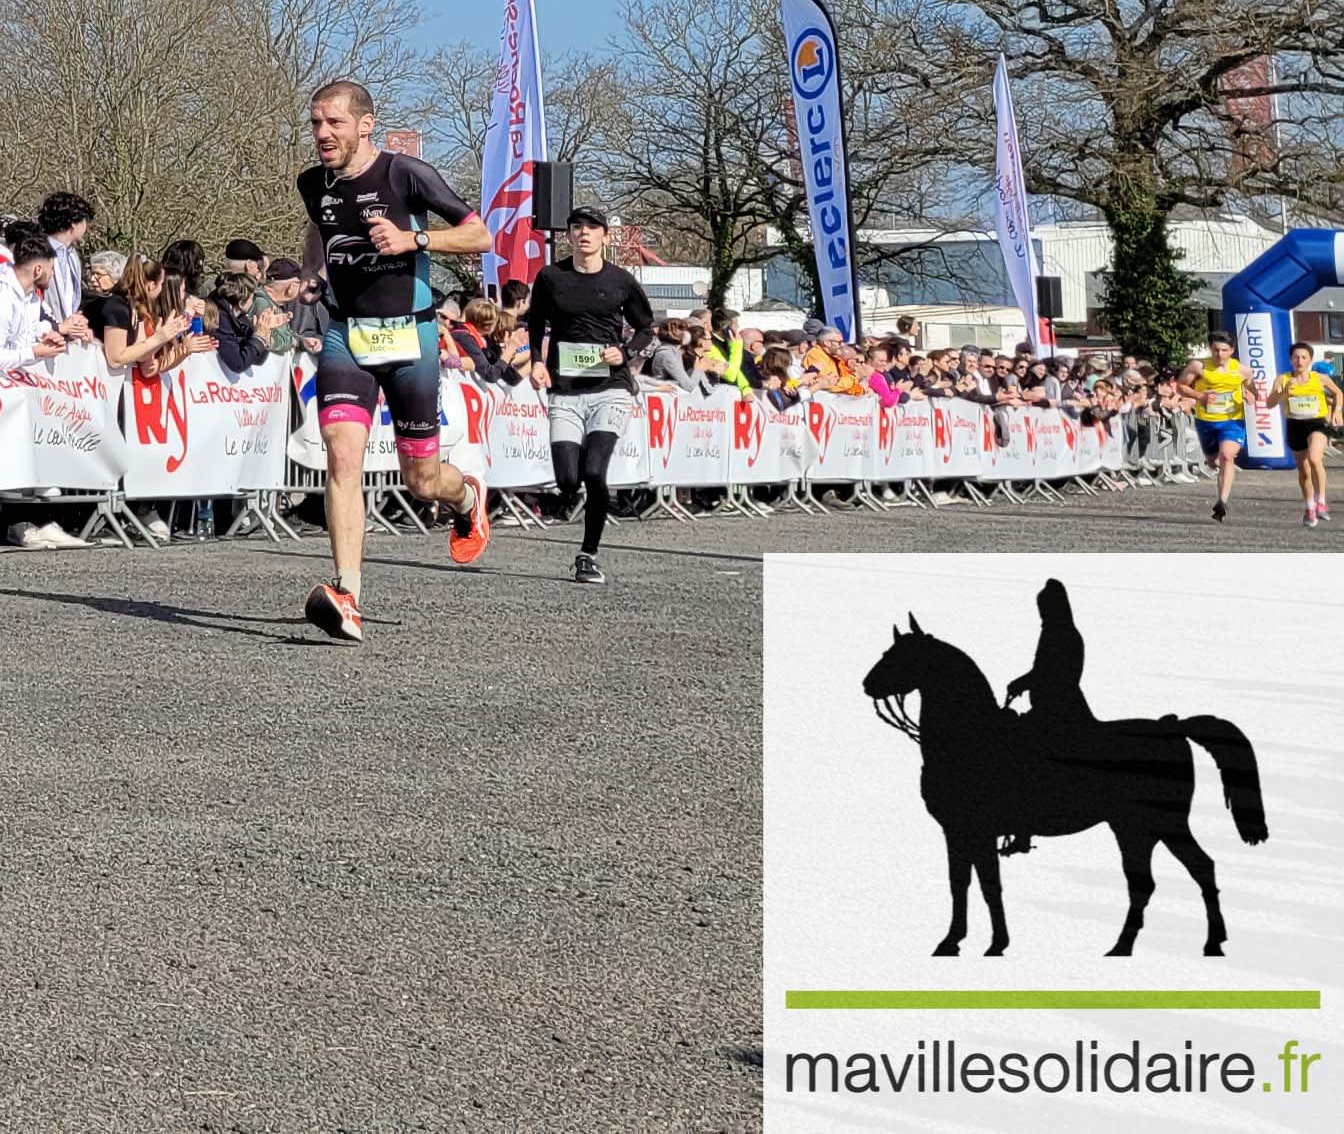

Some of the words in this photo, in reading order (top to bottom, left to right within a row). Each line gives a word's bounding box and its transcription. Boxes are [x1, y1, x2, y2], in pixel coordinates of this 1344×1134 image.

[372, 333, 394, 344] 975
[189, 388, 208, 404] La
[131, 367, 188, 473] Ry
